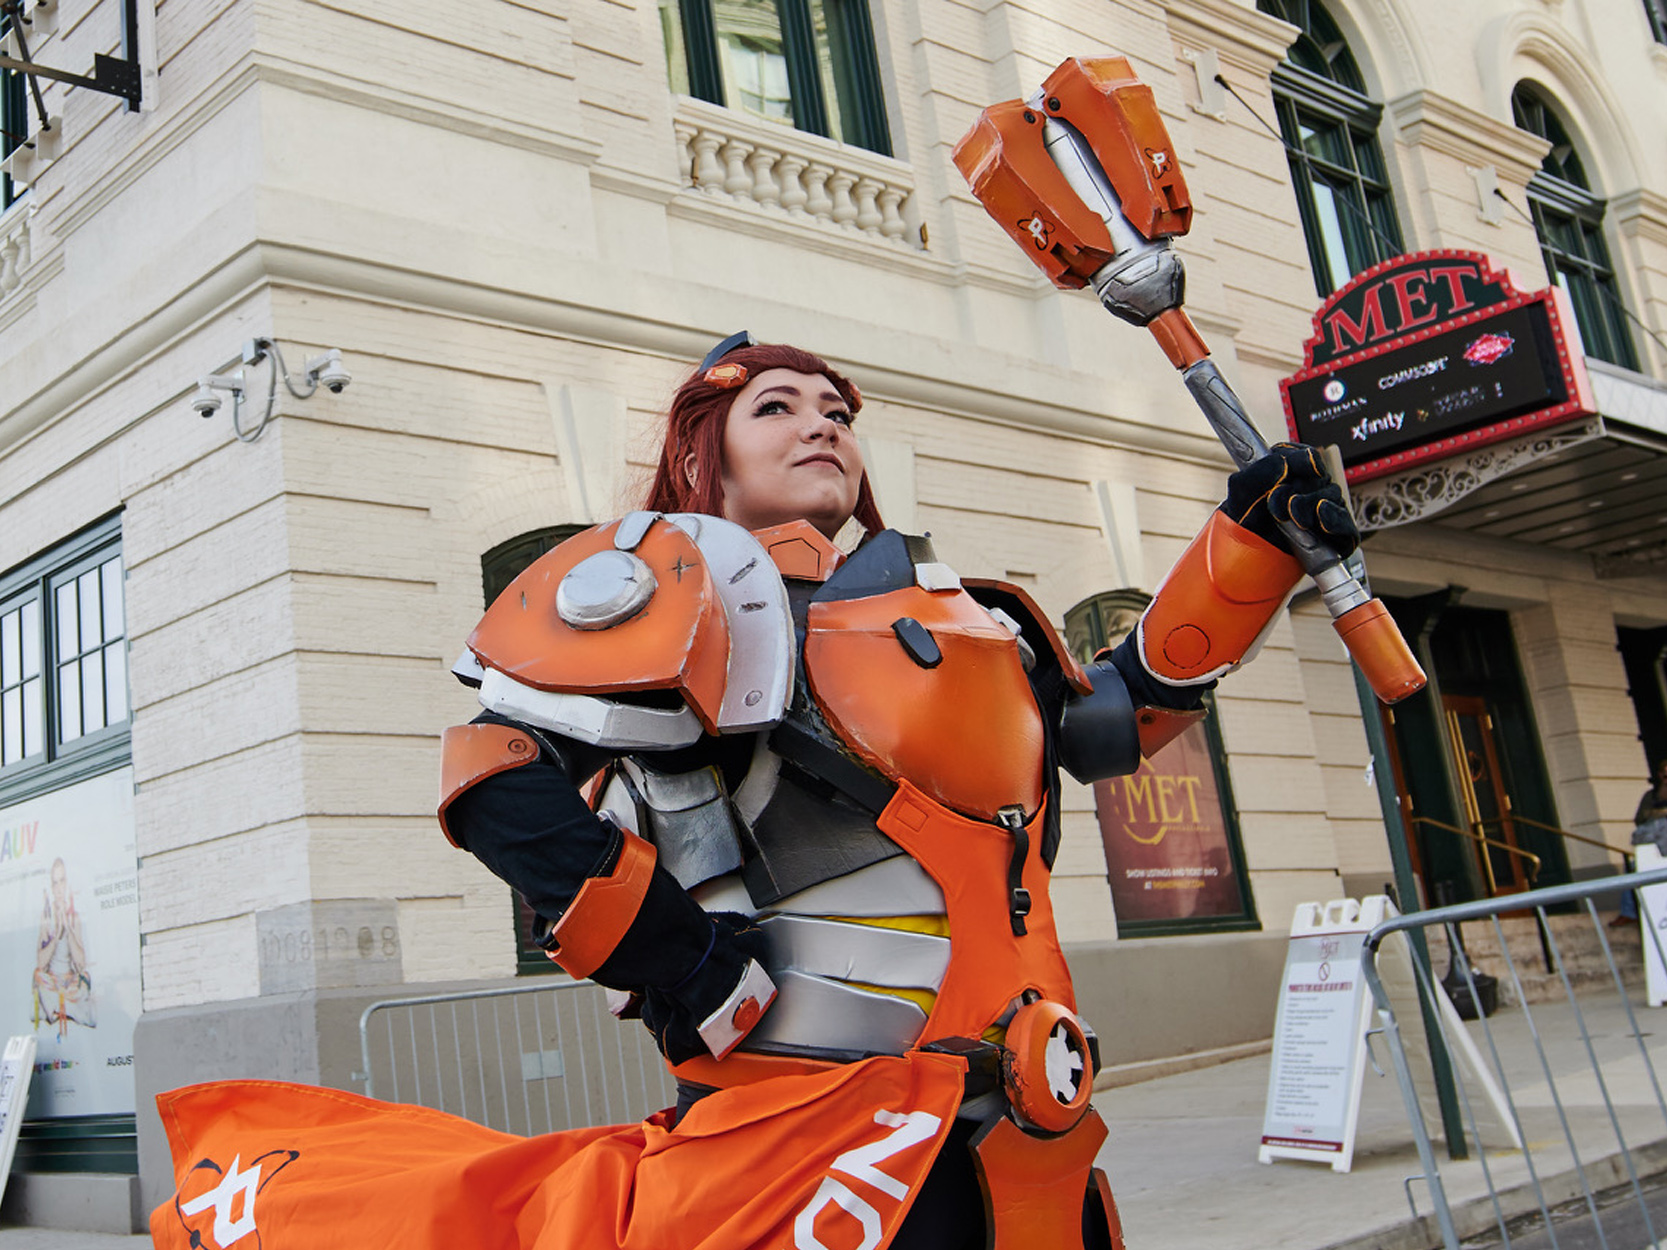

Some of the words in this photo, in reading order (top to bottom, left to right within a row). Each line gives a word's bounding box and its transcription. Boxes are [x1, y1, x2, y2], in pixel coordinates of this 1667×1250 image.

[1325, 266, 1479, 355] MET
[1351, 411, 1405, 441] xfinity
[1123, 774, 1202, 824] MET
[114, 878, 136, 893] PETERS
